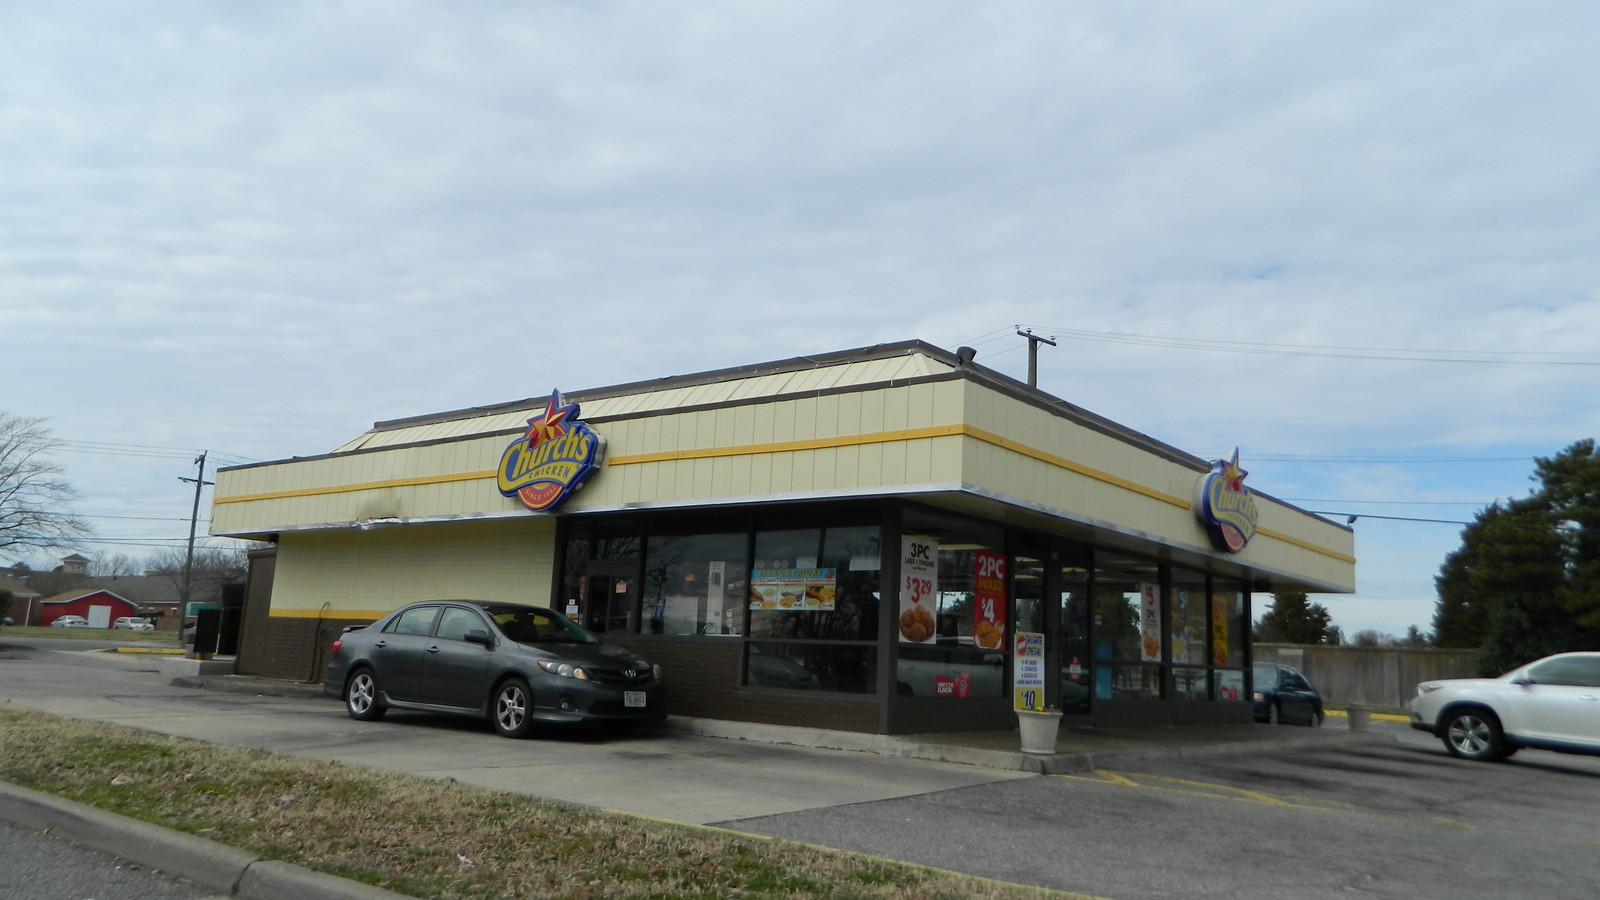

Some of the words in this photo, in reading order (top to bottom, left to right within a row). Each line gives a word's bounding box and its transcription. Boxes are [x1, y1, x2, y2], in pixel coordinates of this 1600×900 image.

[498, 427, 591, 491] Church's
[528, 465, 571, 480] CHICKEN
[525, 488, 541, 501] SINCE
[910, 542, 930, 560] 3PC
[759, 569, 777, 577] FISH
[779, 569, 790, 577] ON
[791, 568, 822, 577] FRIDAY
[978, 555, 1004, 580] 2PC
[978, 578, 1004, 592] MIXED
[981, 598, 995, 623] $4
[1025, 635, 1042, 645] TAILGATE
[1021, 690, 1036, 707] $10
